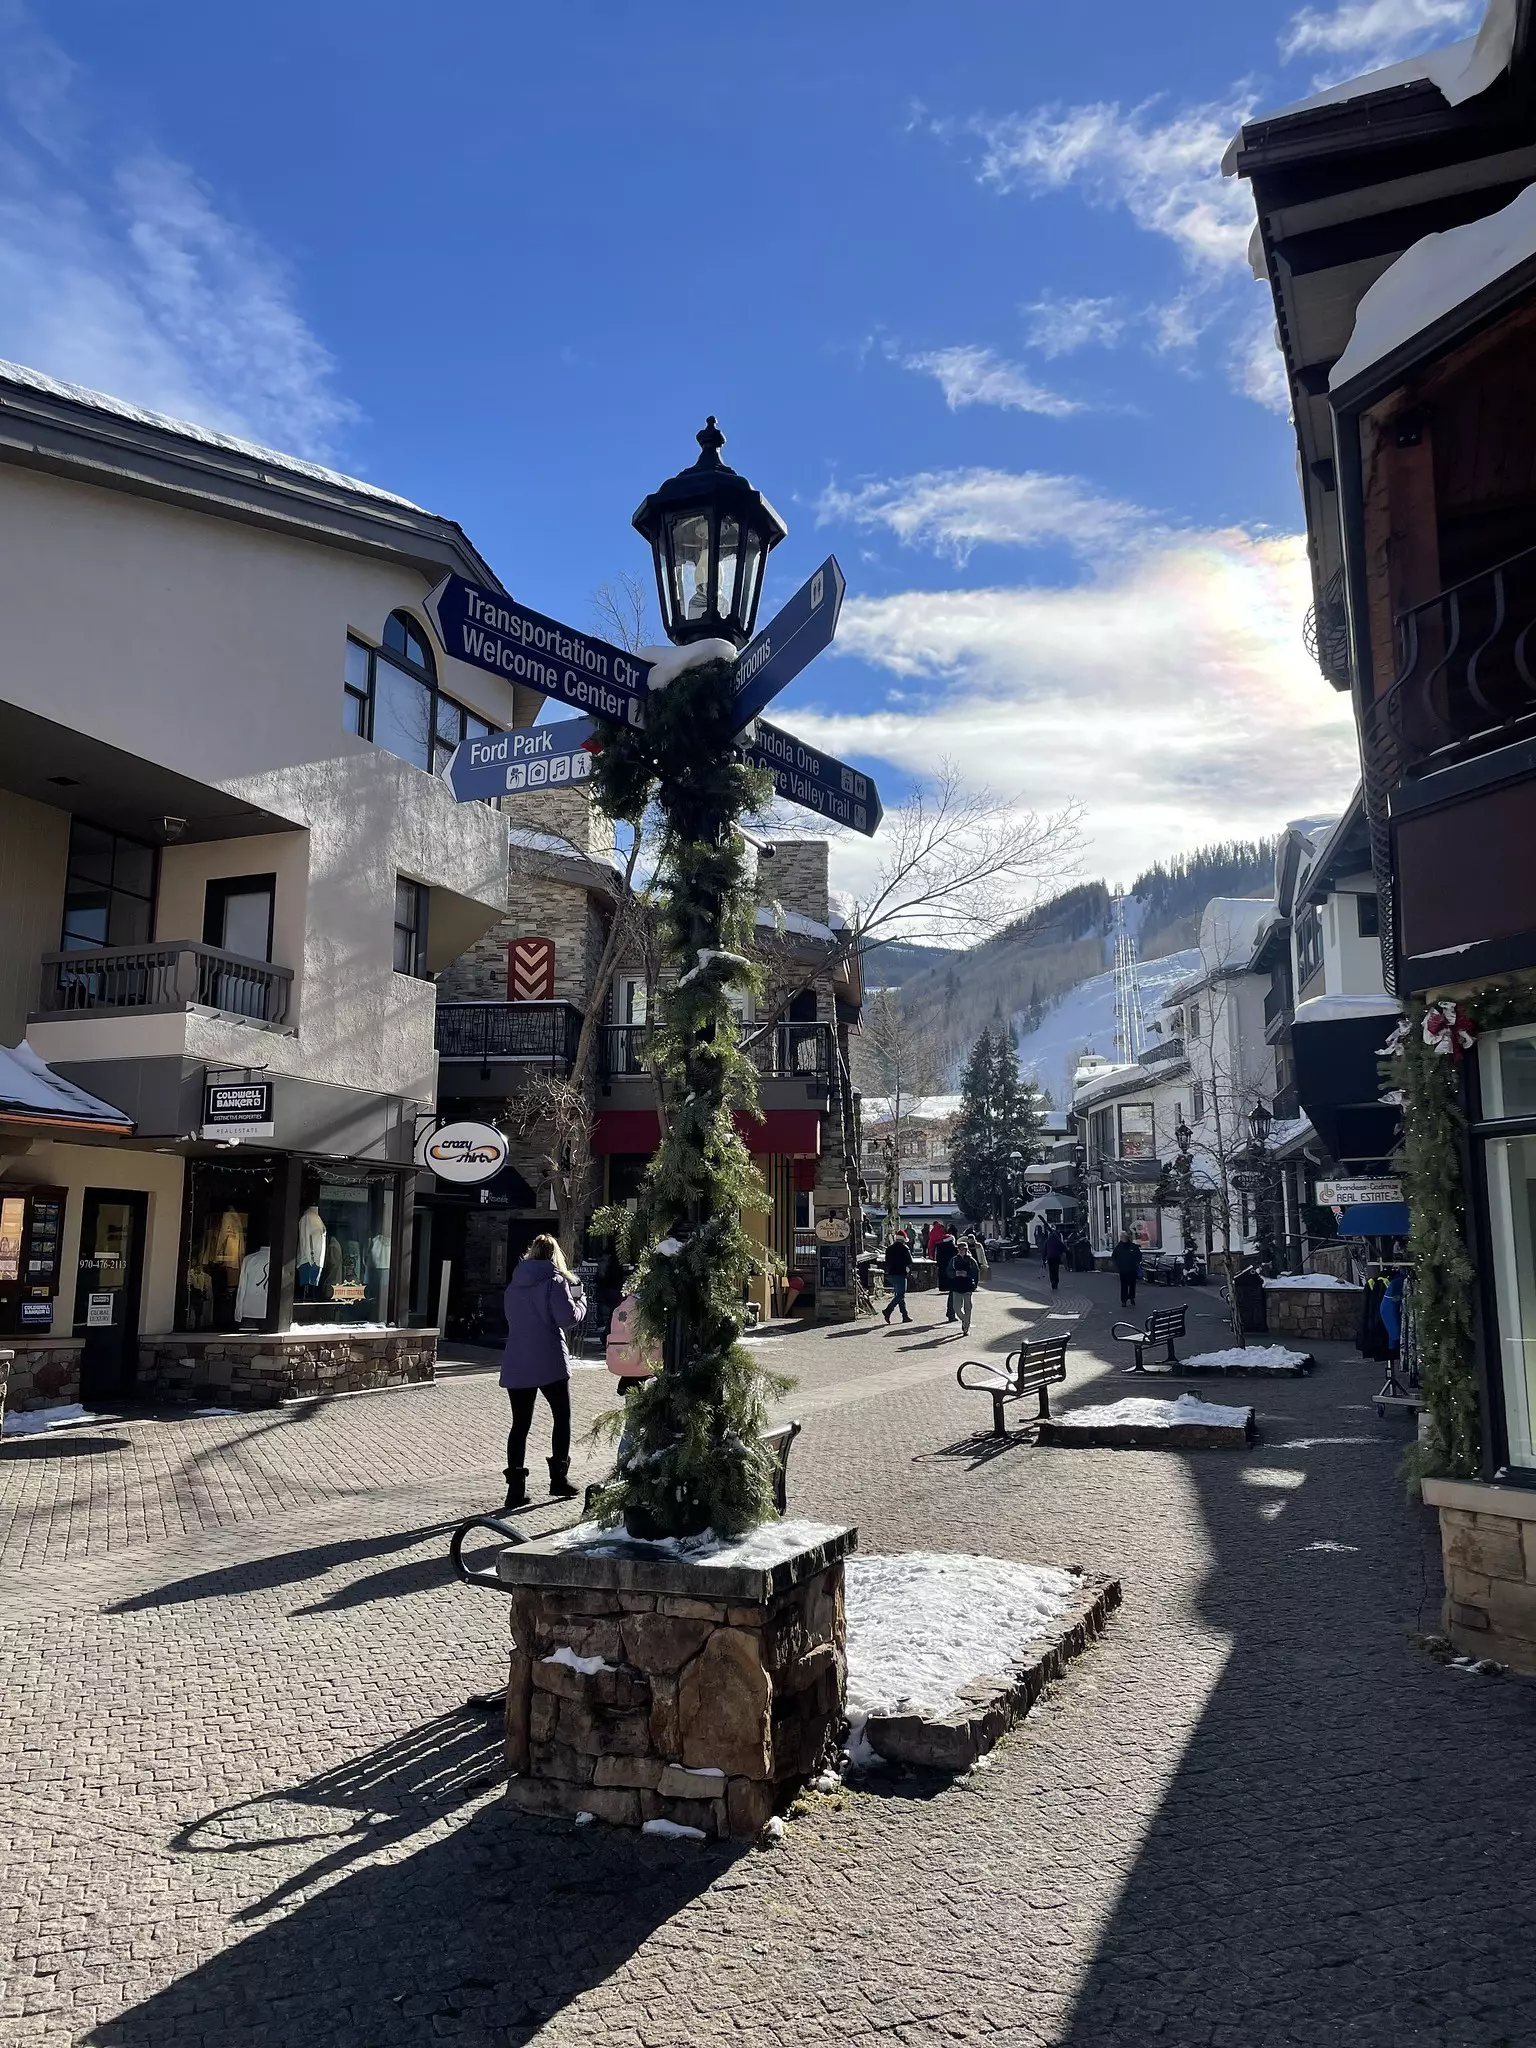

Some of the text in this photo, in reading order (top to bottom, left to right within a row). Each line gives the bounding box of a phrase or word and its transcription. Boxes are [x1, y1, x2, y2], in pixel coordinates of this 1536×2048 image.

[464, 587, 640, 689] Transportation Ctr
[463, 624, 625, 717] Welcome Center
[731, 637, 771, 694] strooms
[470, 730, 553, 765] Ford Park
[756, 731, 820, 776] ndola One
[790, 772, 825, 811] Valley
[827, 790, 850, 820] Trail
[442, 1140, 473, 1151] crazy
[1336, 1193, 1358, 1202] REAL
[1360, 1192, 1391, 1201] ESTATE
[79, 1259, 127, 1269] 970-476-2113
